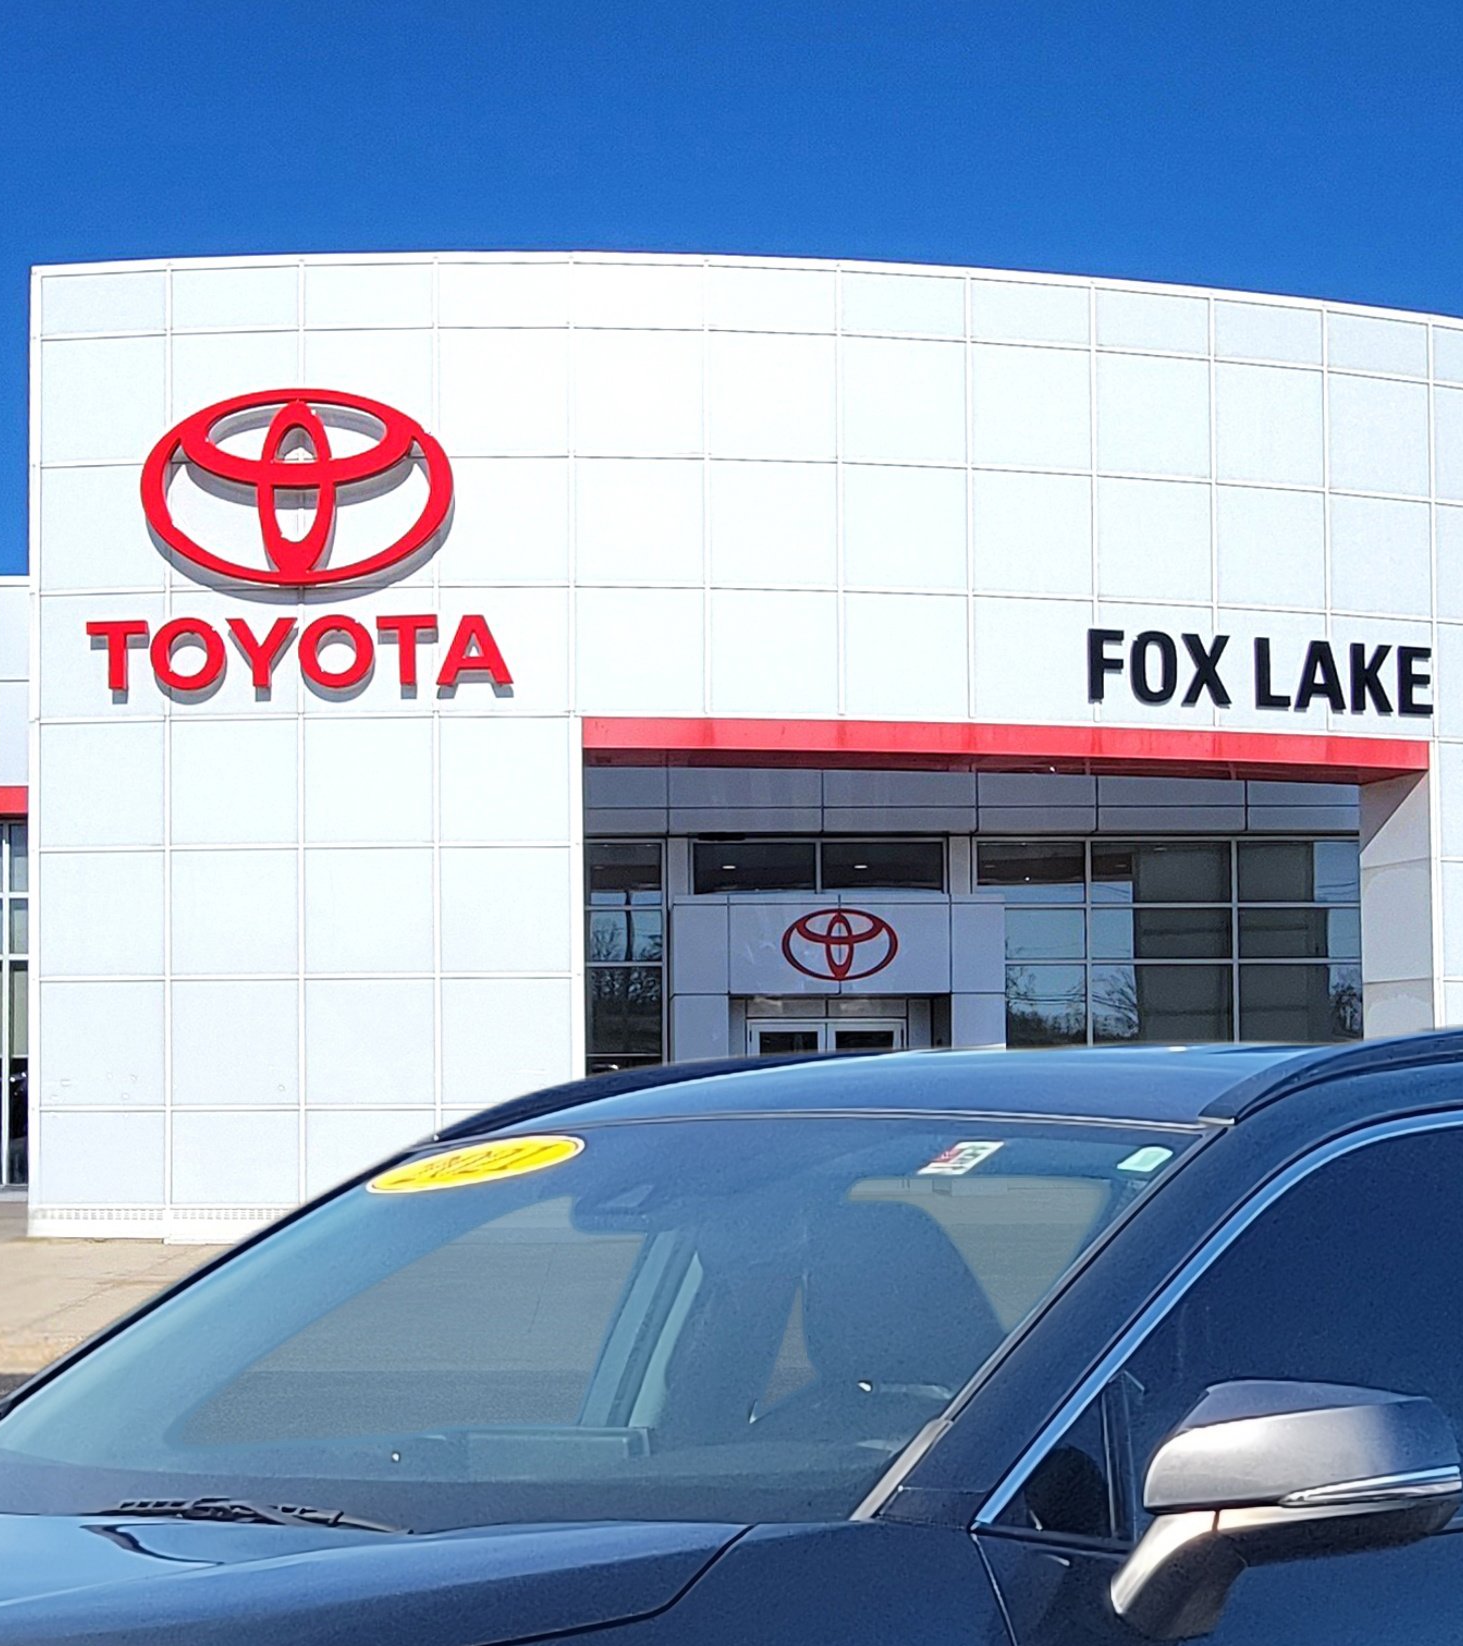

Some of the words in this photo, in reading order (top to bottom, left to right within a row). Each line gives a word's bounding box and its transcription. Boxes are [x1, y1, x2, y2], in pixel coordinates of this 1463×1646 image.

[86, 614, 515, 691] TOYOTA
[1087, 628, 1232, 707] FOX
[1253, 636, 1435, 716] LAKE
